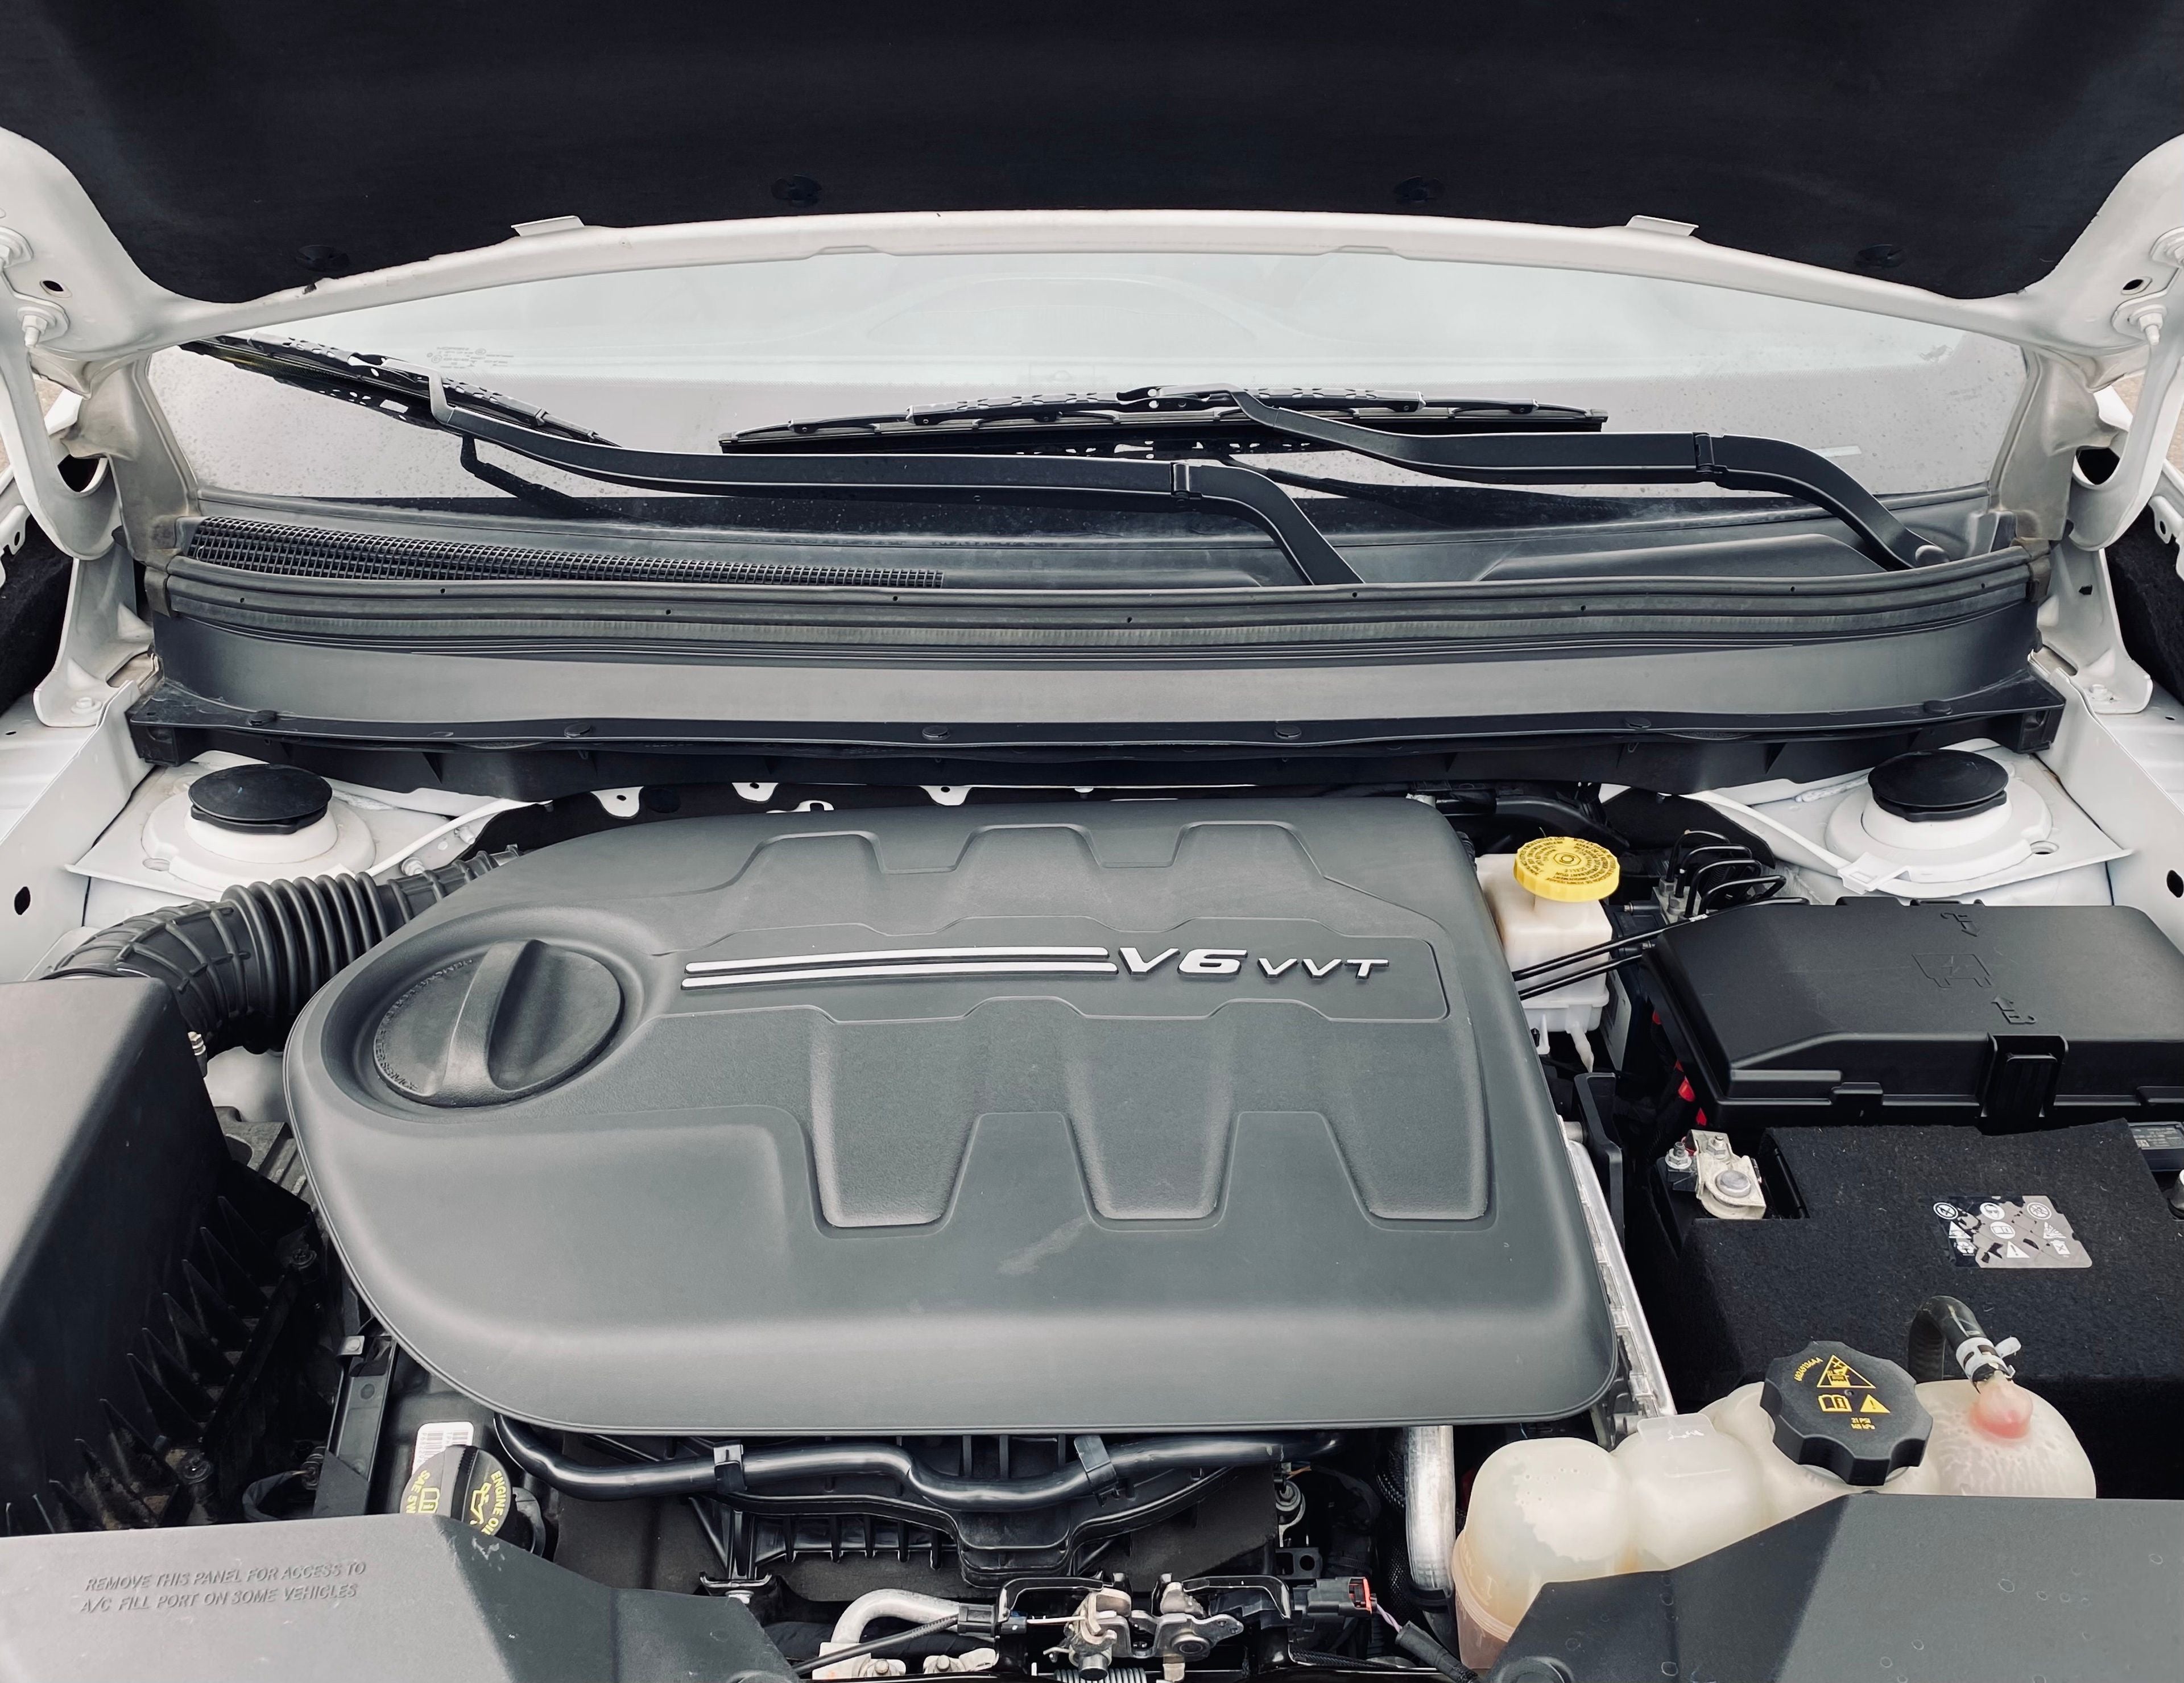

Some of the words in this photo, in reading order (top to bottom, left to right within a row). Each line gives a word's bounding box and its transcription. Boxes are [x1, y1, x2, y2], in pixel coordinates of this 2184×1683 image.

[1118, 946, 1248, 976] V6
[1258, 957, 1389, 979] VVT
[411, 1470, 431, 1494] SAE
[491, 1470, 507, 1516] ENGINE
[406, 1495, 418, 1514] 5W
[481, 1517, 499, 1535] OIL
[85, 1574, 152, 1591] REMOVE
[156, 1572, 190, 1587] THIS
[193, 1569, 242, 1585] PANEL
[246, 1566, 279, 1582] FOR
[281, 1562, 342, 1580] ACCESS
[348, 1561, 367, 1576] TO
[80, 1596, 112, 1613] A/C
[118, 1595, 150, 1611] FILL
[156, 1592, 200, 1608] PORT
[204, 1591, 228, 1606] ON
[231, 1588, 278, 1605] SOME
[284, 1583, 358, 1601] VEHICLES
